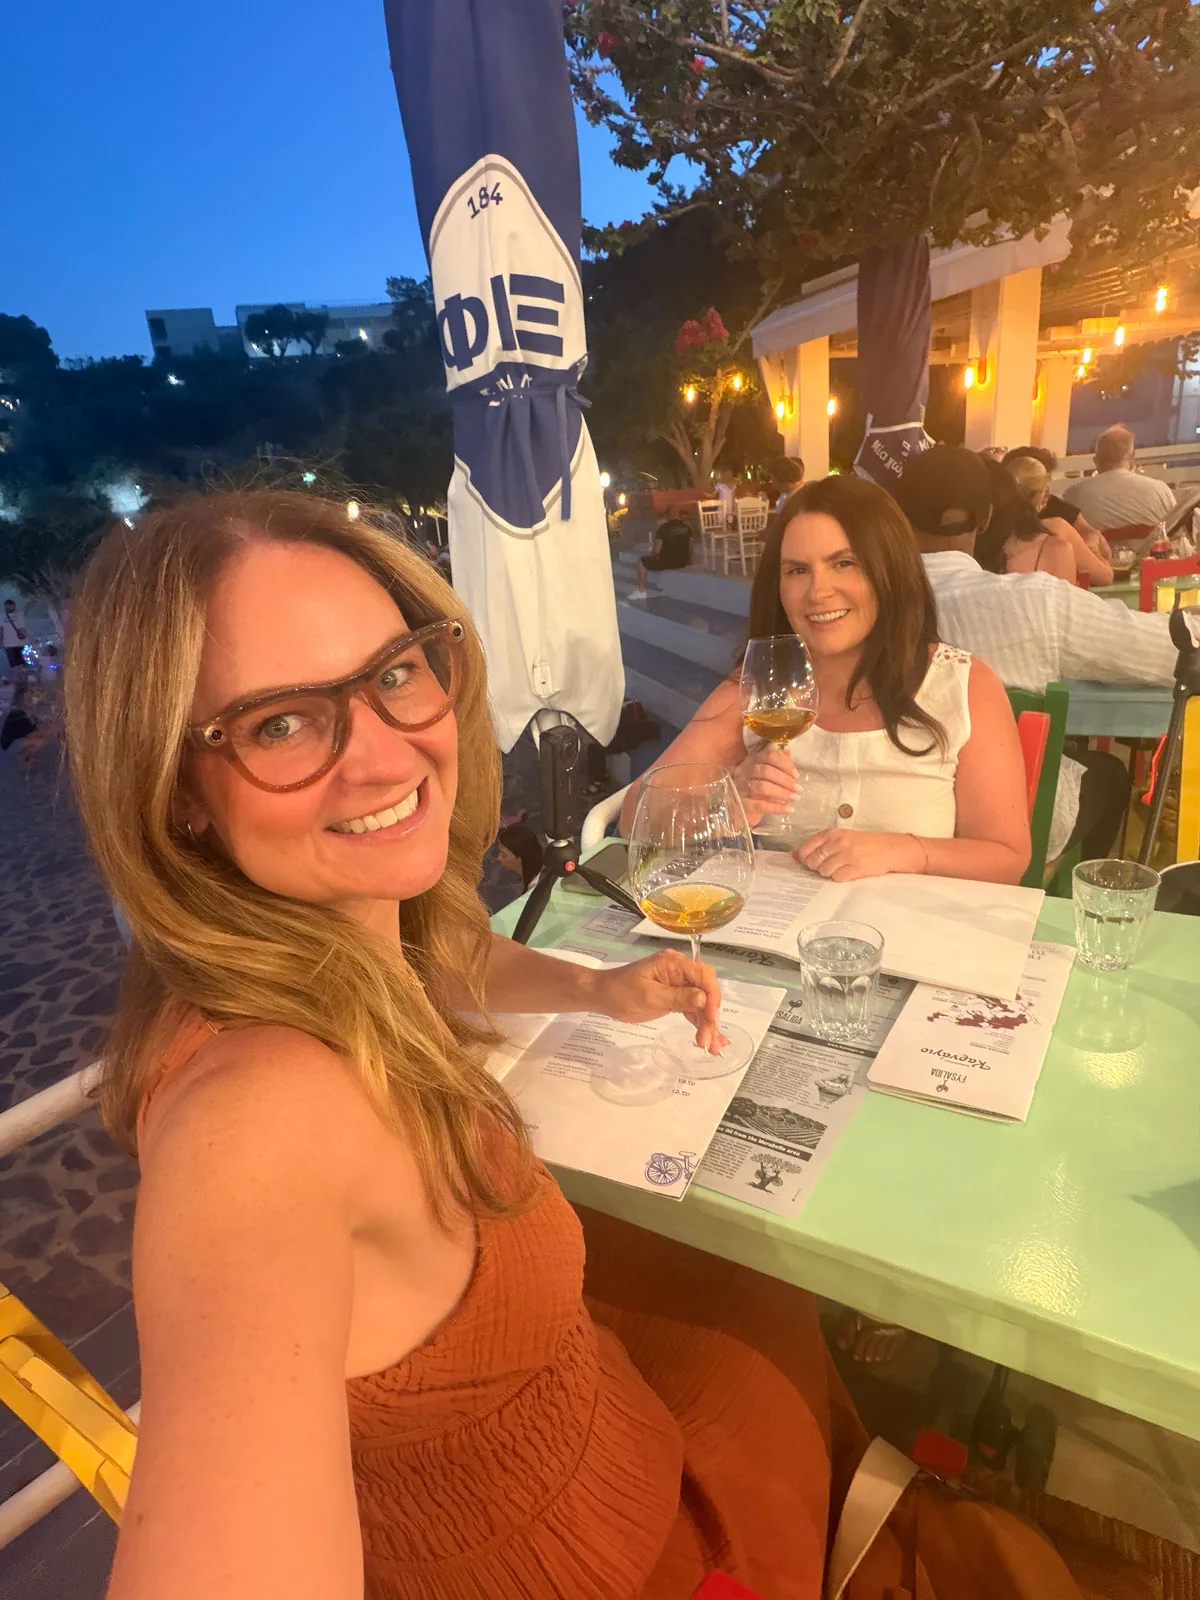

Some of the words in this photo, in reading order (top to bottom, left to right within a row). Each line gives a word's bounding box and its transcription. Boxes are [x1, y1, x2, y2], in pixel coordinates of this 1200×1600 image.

[930, 1067, 968, 1084] FYSALIDA
[733, 1130, 748, 1140] from
[747, 1134, 758, 1143] the
[786, 1148, 801, 1157] area
